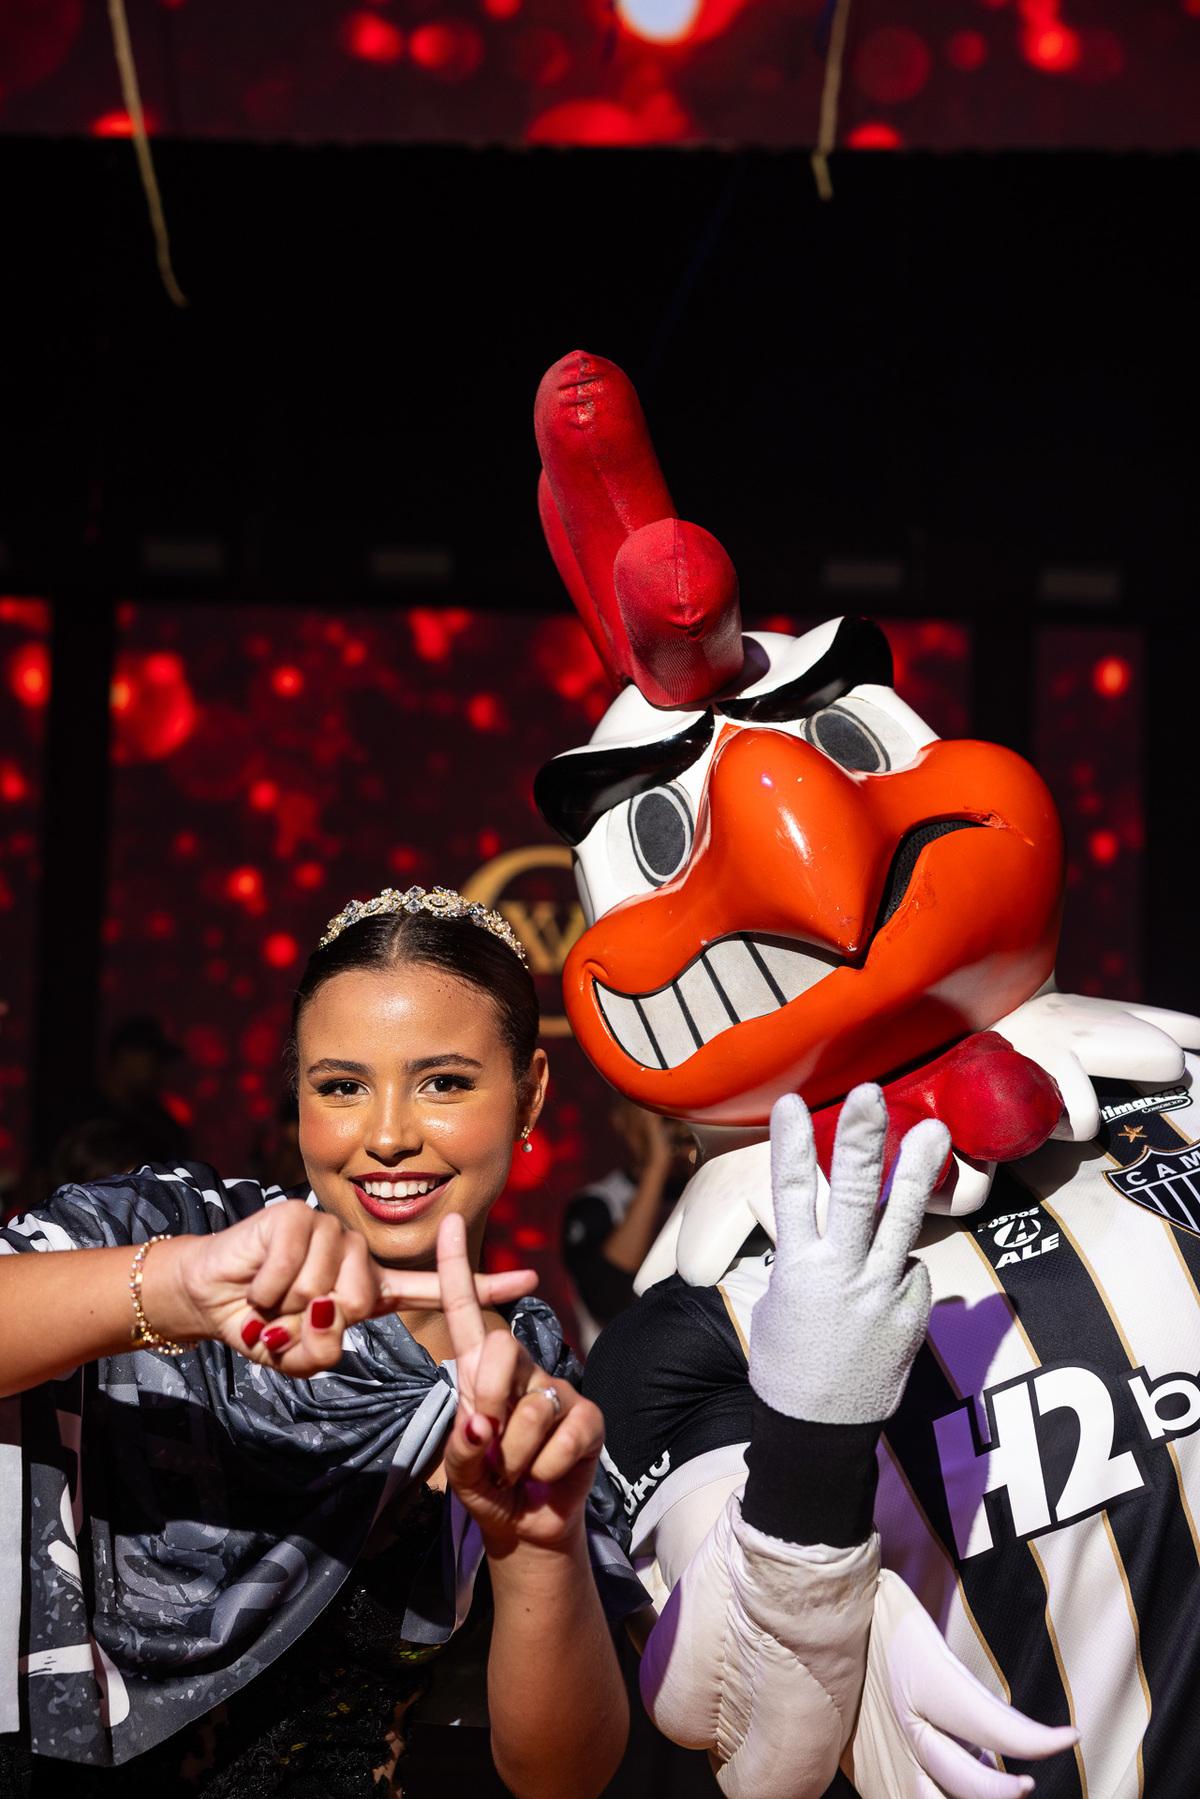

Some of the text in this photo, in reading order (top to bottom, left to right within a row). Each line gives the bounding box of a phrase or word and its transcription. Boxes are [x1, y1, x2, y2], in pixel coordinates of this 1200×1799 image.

[1100, 1086, 1187, 1120] timarcas
[977, 1206, 1040, 1233] POSTOS
[994, 1232, 1059, 1270] ALE
